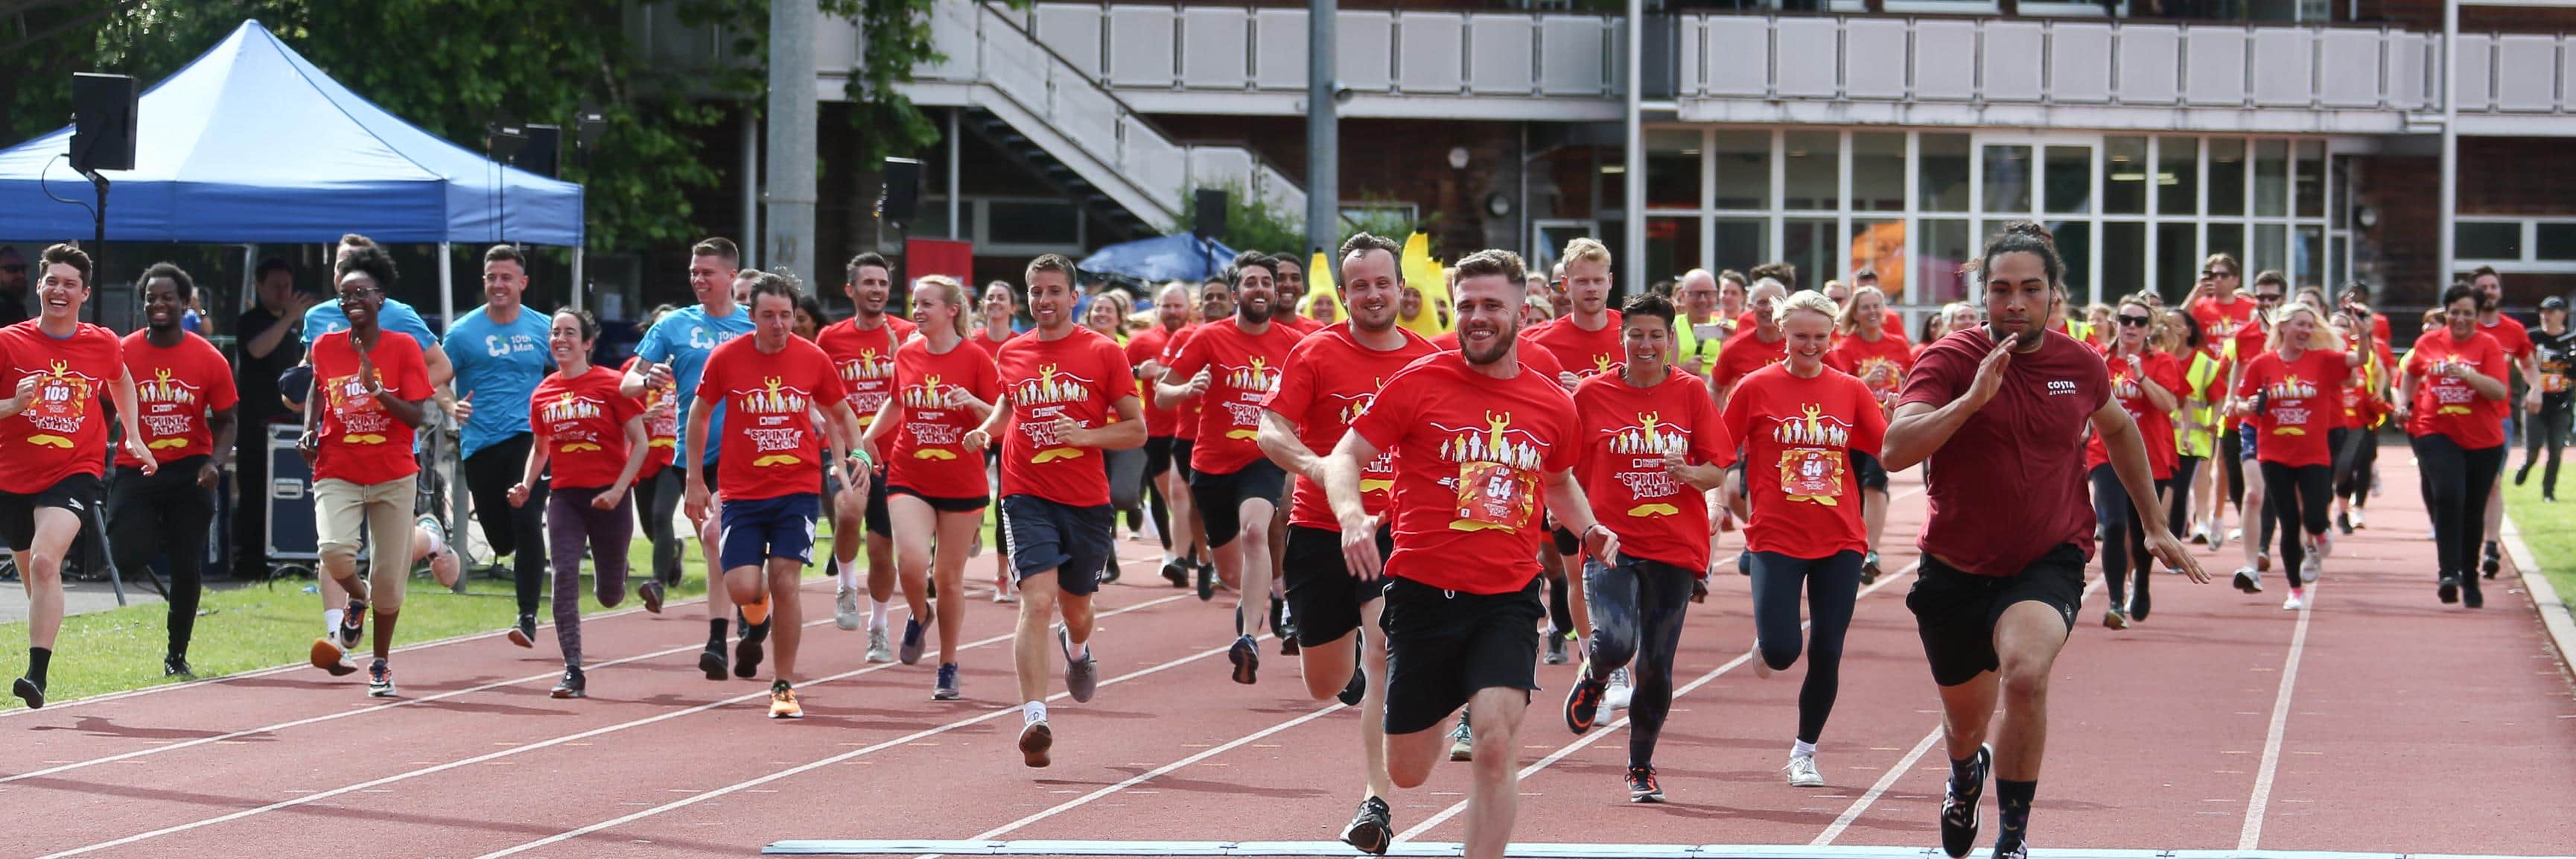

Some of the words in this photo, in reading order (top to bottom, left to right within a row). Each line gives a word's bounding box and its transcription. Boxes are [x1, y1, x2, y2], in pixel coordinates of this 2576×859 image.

[511, 335, 532, 344] 10th
[513, 343, 534, 352] Man
[2047, 381, 2076, 389] COSTA
[44, 386, 69, 401] 103
[751, 428, 795, 440] SPRINT
[912, 422, 950, 434] SPRINT
[757, 437, 799, 452] ATHON
[917, 430, 956, 446] ATHON
[1495, 466, 1510, 477] LAP
[1802, 460, 1823, 477] 54
[1623, 471, 1668, 486] SPRINT
[1486, 476, 1513, 500] 54
[1632, 481, 1680, 500] ATHON
